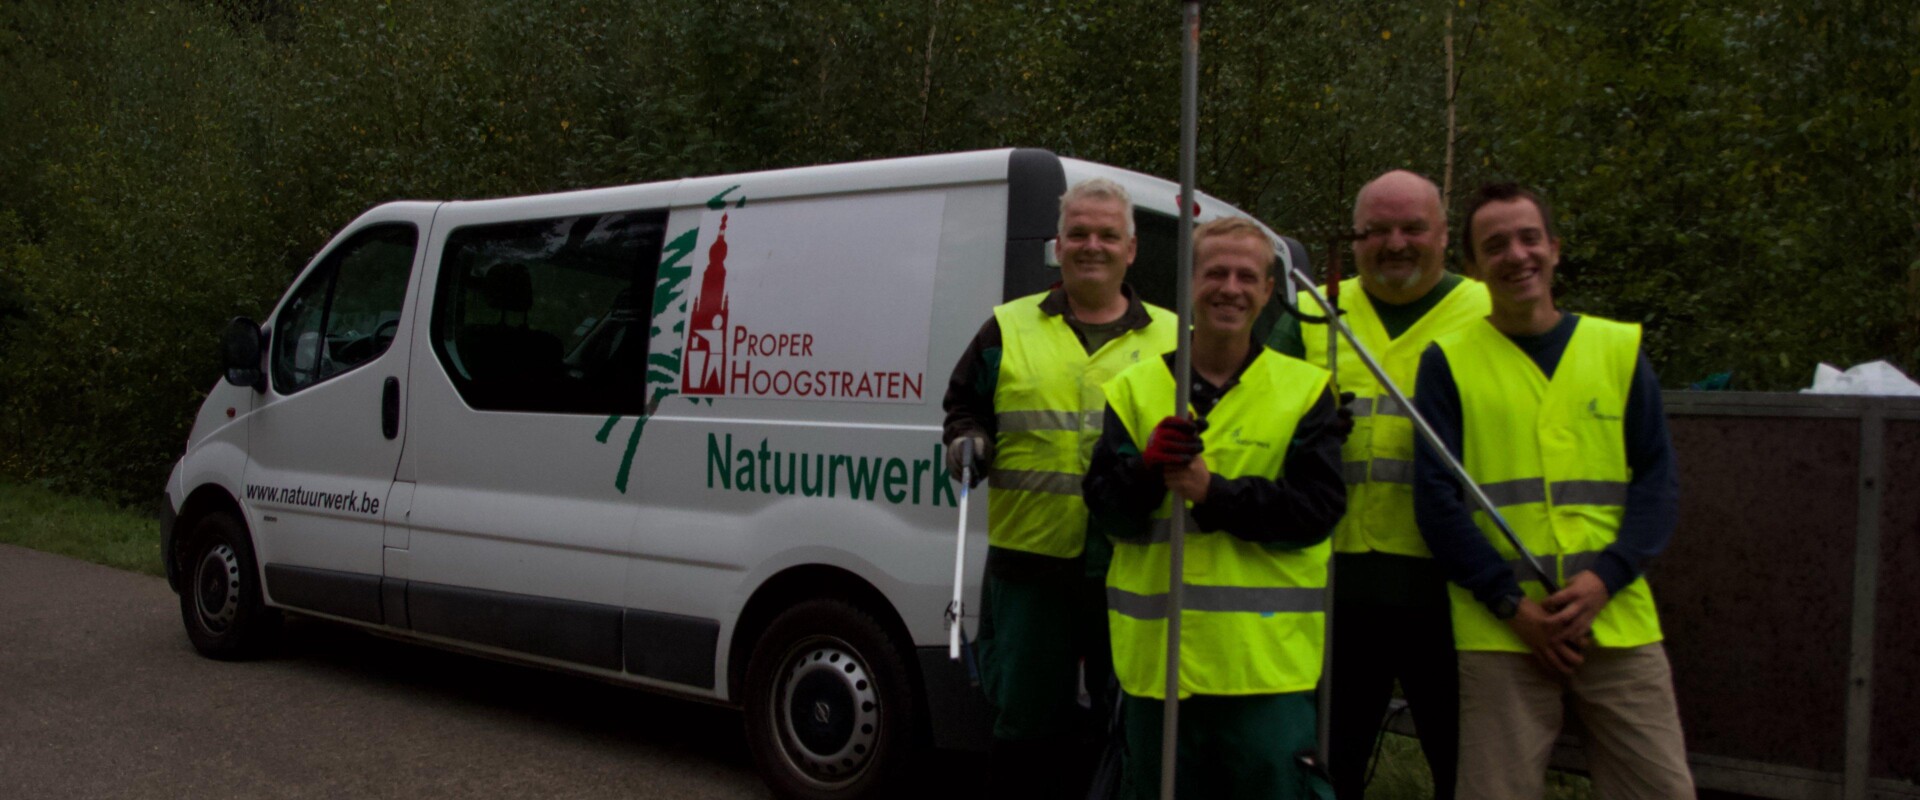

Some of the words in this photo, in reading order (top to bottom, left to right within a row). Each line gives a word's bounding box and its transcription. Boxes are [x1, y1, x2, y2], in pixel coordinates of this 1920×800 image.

[733, 326, 814, 356] PROPER
[731, 361, 922, 399] HOOGSTRATEN
[708, 433, 957, 507] Natuurwerk
[246, 484, 380, 514] www.natuurwerk.be
